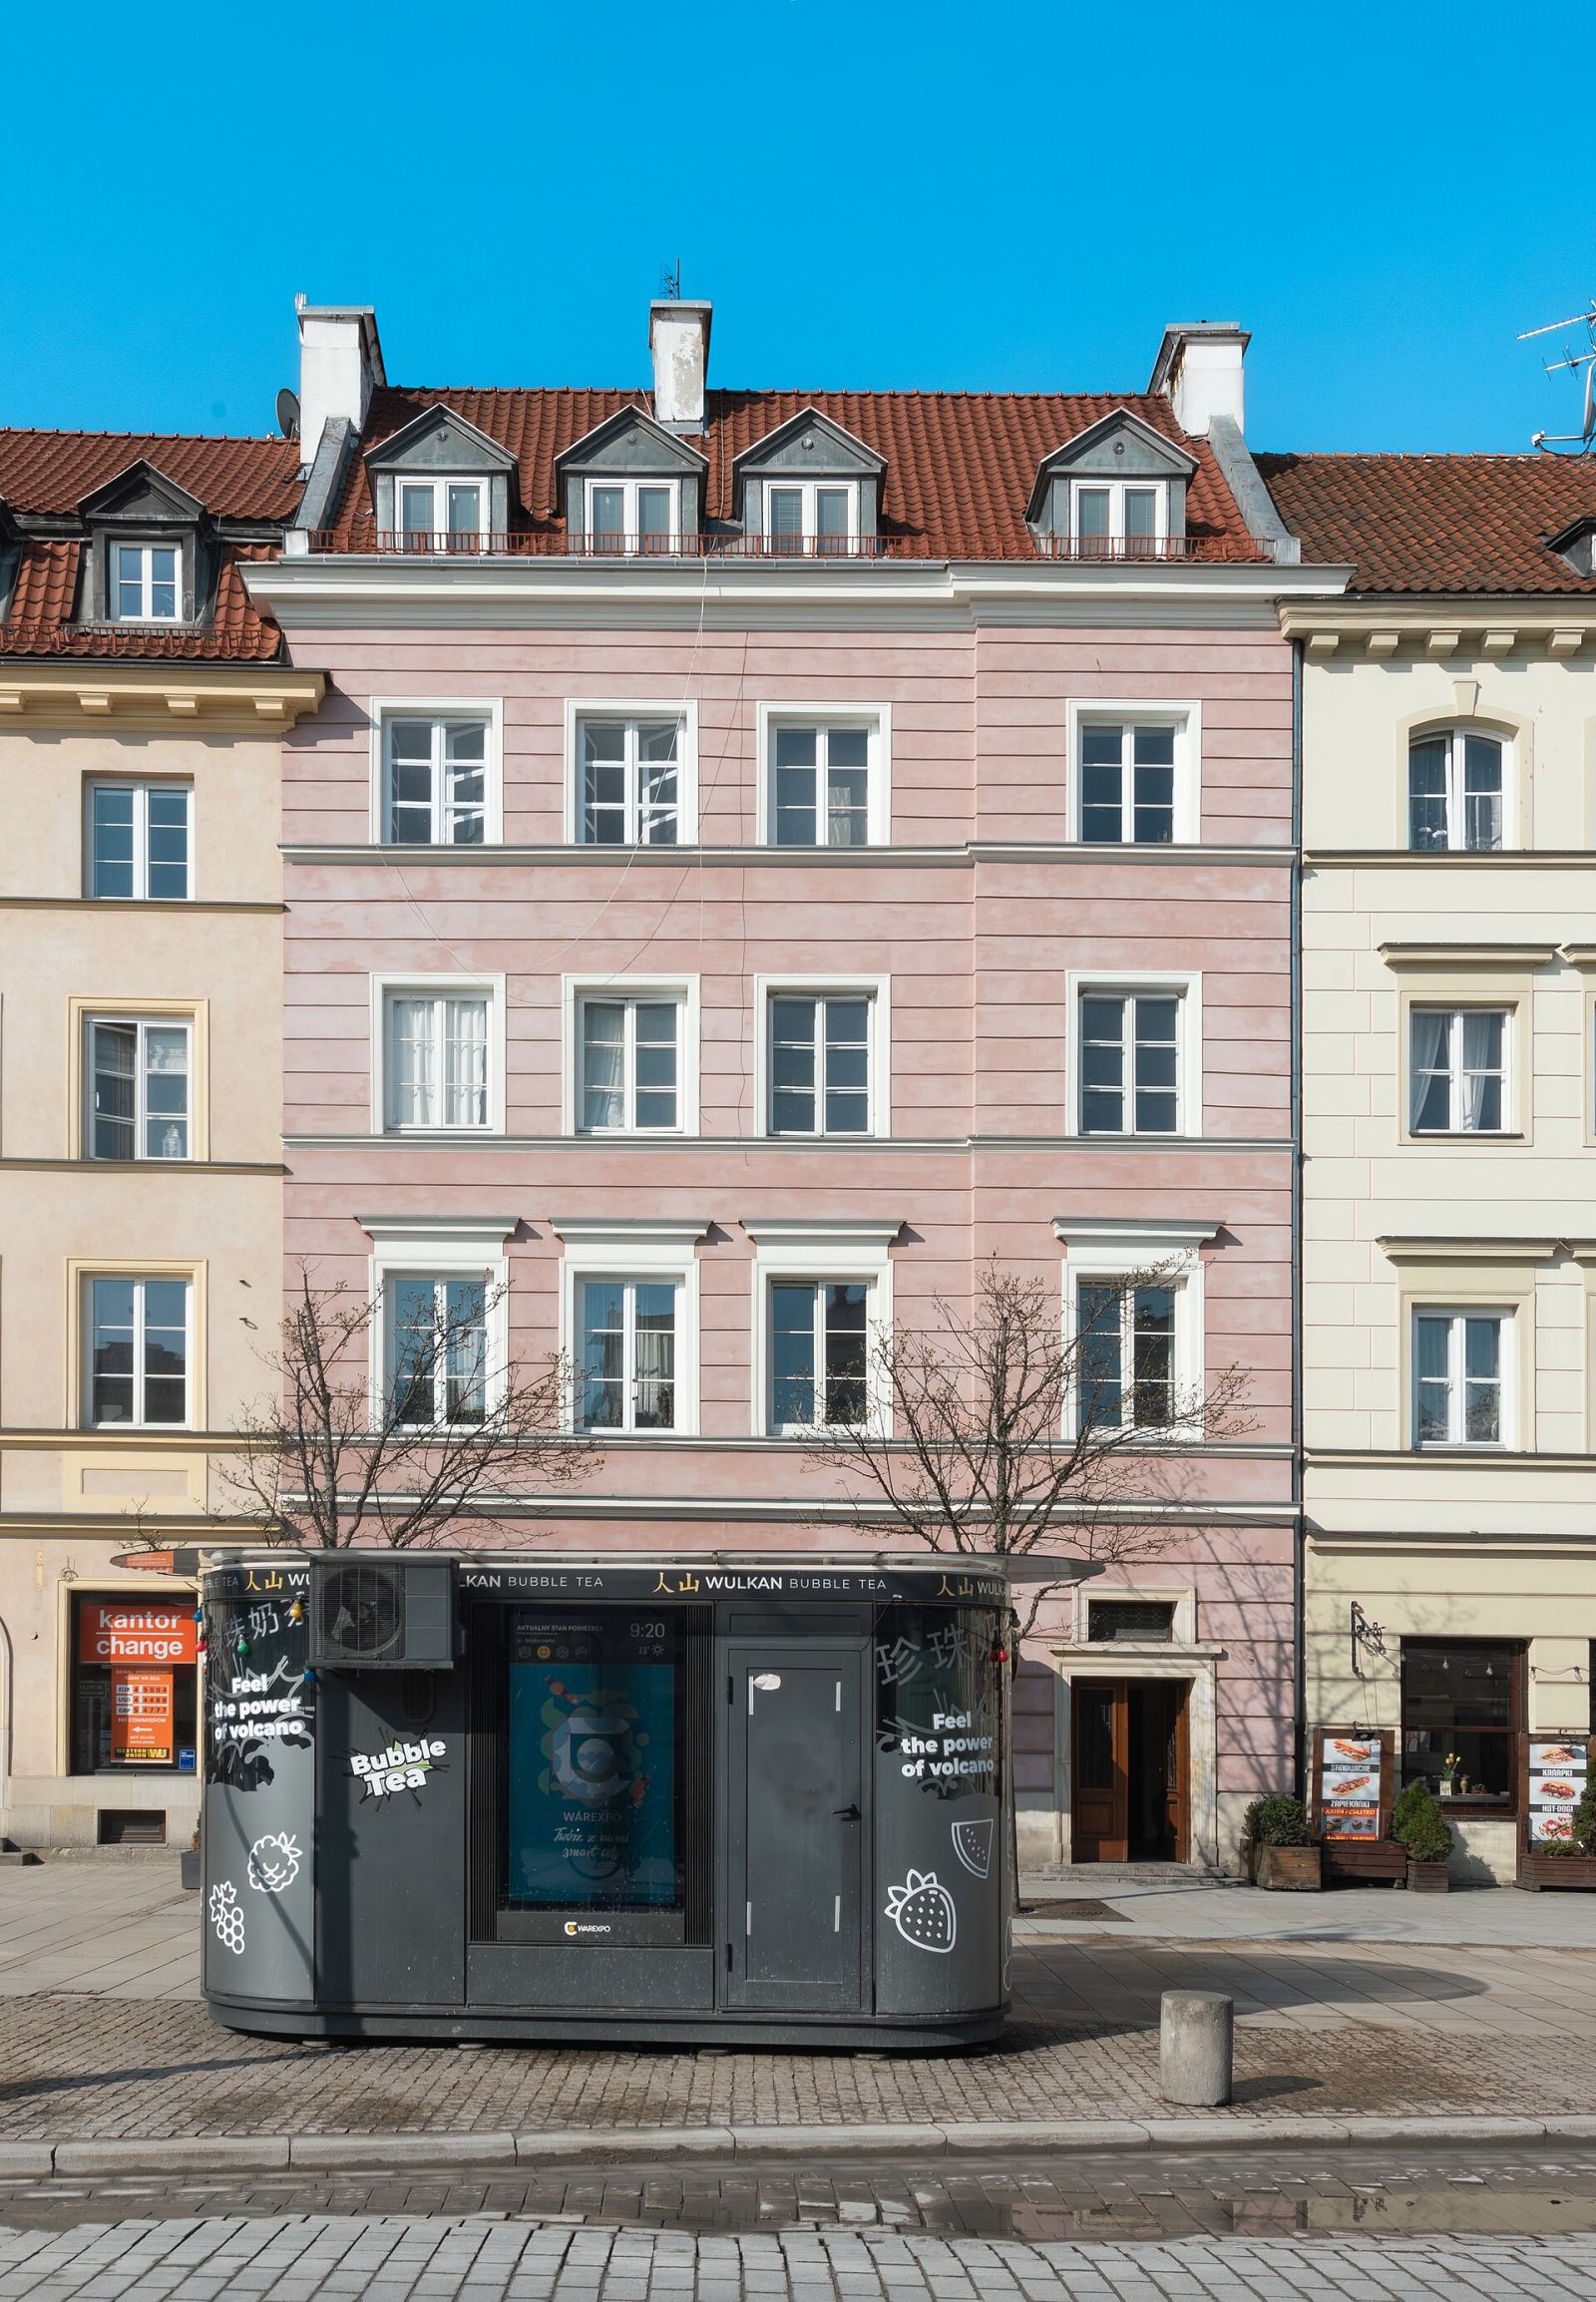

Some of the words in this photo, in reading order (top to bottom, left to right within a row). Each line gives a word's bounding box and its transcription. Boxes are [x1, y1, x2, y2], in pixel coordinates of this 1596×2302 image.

[221, 1576, 238, 1587] TEA
[508, 1576, 568, 1587] BUBBLE
[576, 1577, 603, 1587] TEA
[705, 1576, 783, 1590] WULKAN
[789, 1578, 851, 1589] BUBBLE
[858, 1579, 887, 1590] TEA
[99, 1609, 182, 1630] kantor
[629, 1623, 665, 1638] 9:20
[96, 1636, 184, 1660] change
[231, 1674, 268, 1694] Feel
[214, 1701, 236, 1719] the
[239, 1698, 301, 1720] power
[214, 1723, 227, 1740] of
[229, 1720, 303, 1738] volcano
[933, 1711, 972, 1729] Feel
[901, 1736, 939, 1754] the
[943, 1736, 994, 1756] power
[350, 1738, 447, 1775] Bubble
[901, 1759, 925, 1777] of
[929, 1757, 995, 1776] volcano
[363, 1767, 427, 1796] Tea
[563, 1811, 622, 1822] WAREXPO
[563, 1845, 599, 1859] smart
